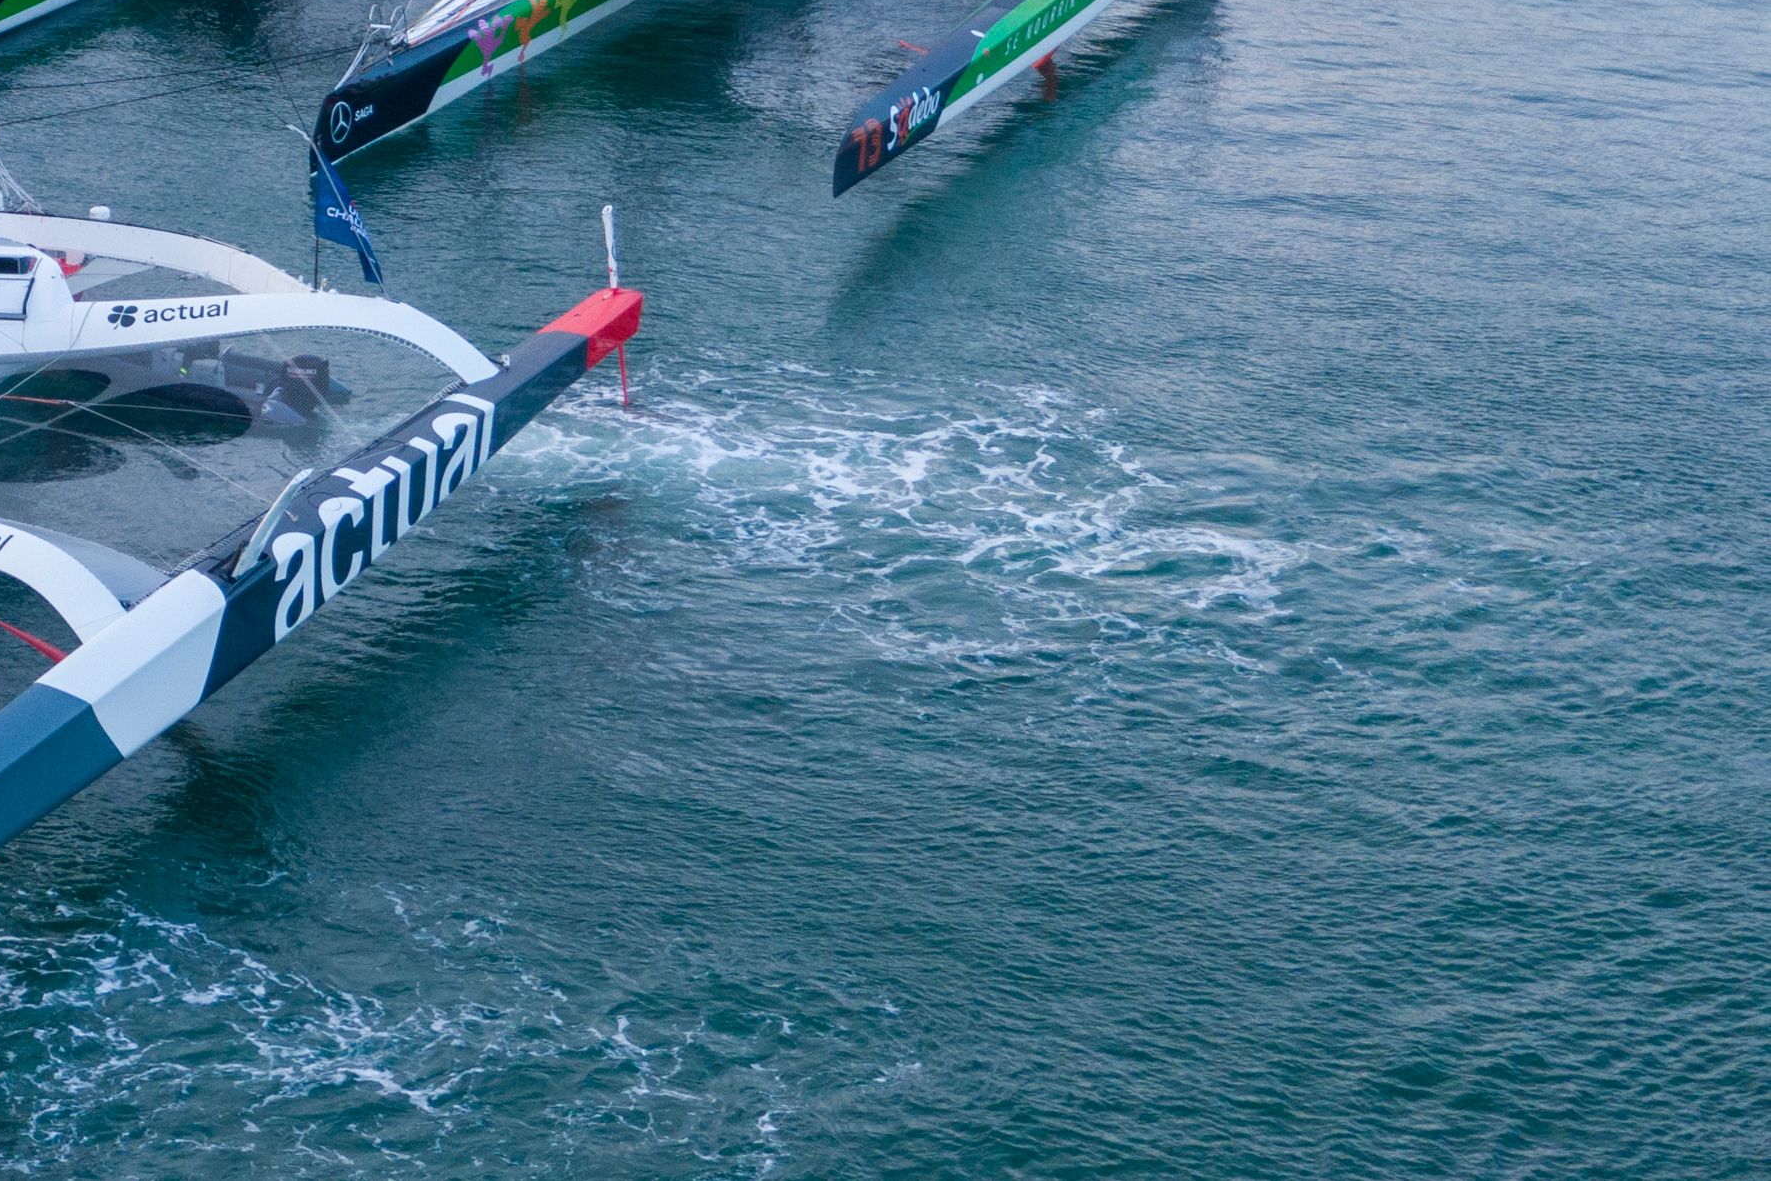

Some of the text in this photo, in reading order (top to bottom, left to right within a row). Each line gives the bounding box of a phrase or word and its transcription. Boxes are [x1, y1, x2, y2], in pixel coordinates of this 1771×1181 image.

[1004, 35, 1019, 56] SE
[354, 104, 373, 122] SAGA
[887, 84, 941, 152] Sodebo
[852, 118, 884, 173] 73
[142, 299, 231, 326] actual
[272, 391, 497, 644] actual
